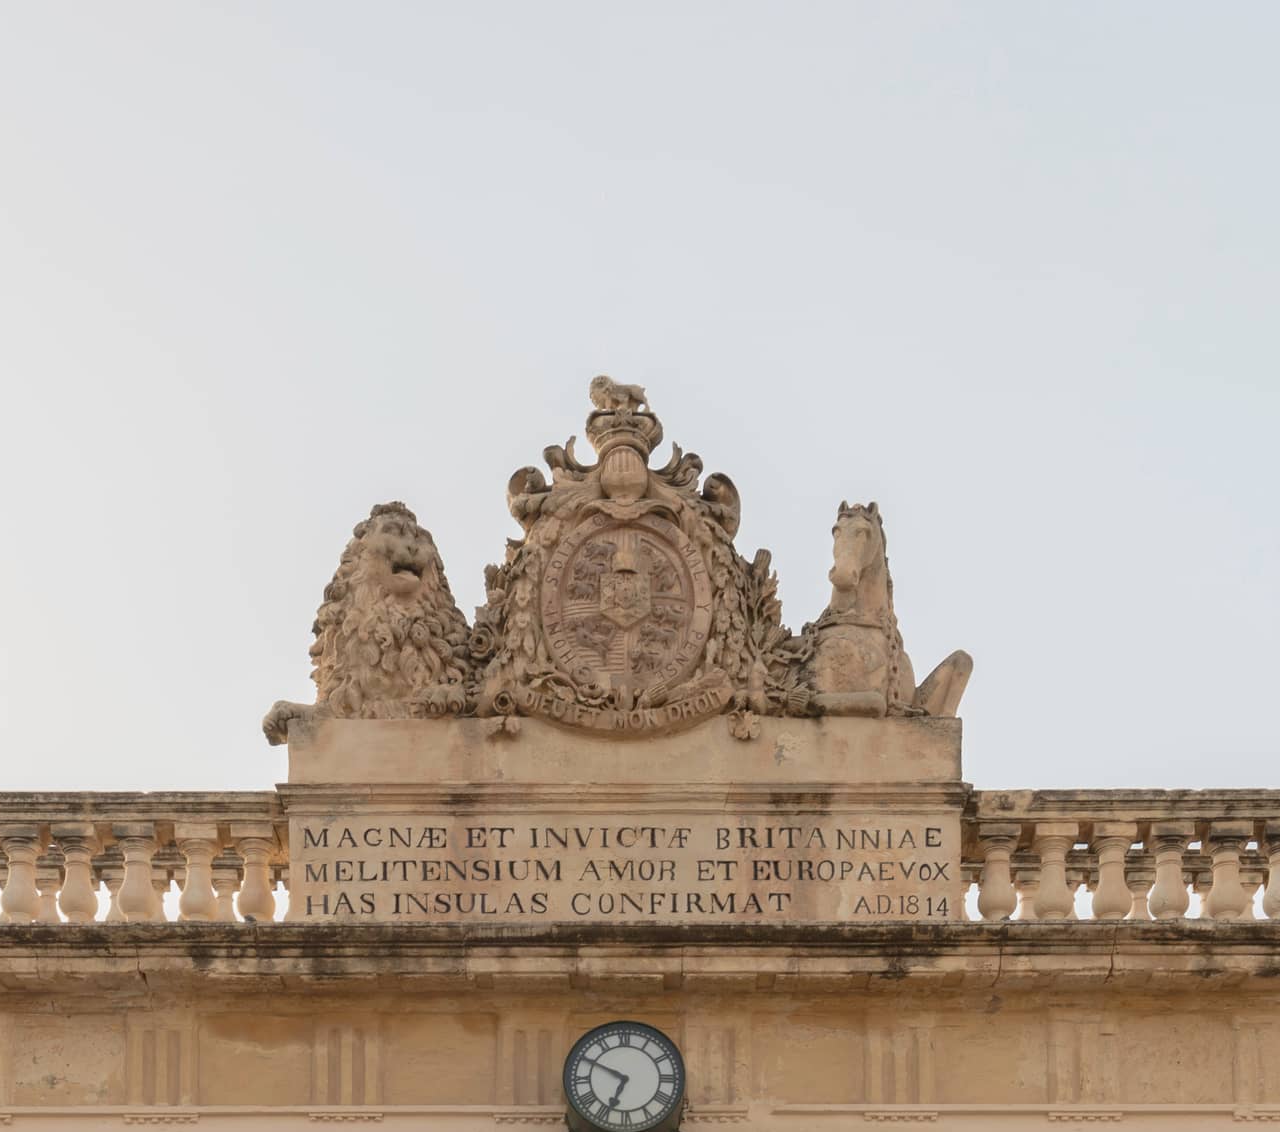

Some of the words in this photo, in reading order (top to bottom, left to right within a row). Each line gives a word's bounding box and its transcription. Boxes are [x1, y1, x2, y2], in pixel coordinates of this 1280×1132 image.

[614, 706, 661, 730] MON
[667, 689, 722, 721] DROIT
[464, 827, 516, 848] ET
[715, 827, 943, 850] BRITANNIAE
[305, 859, 562, 882] MELITENSIUM
[578, 860, 677, 882] AMOR
[697, 860, 738, 881] ET
[306, 892, 376, 916] HAS
[391, 893, 549, 915] INSULAS
[571, 892, 792, 915] CONFIRMAT
